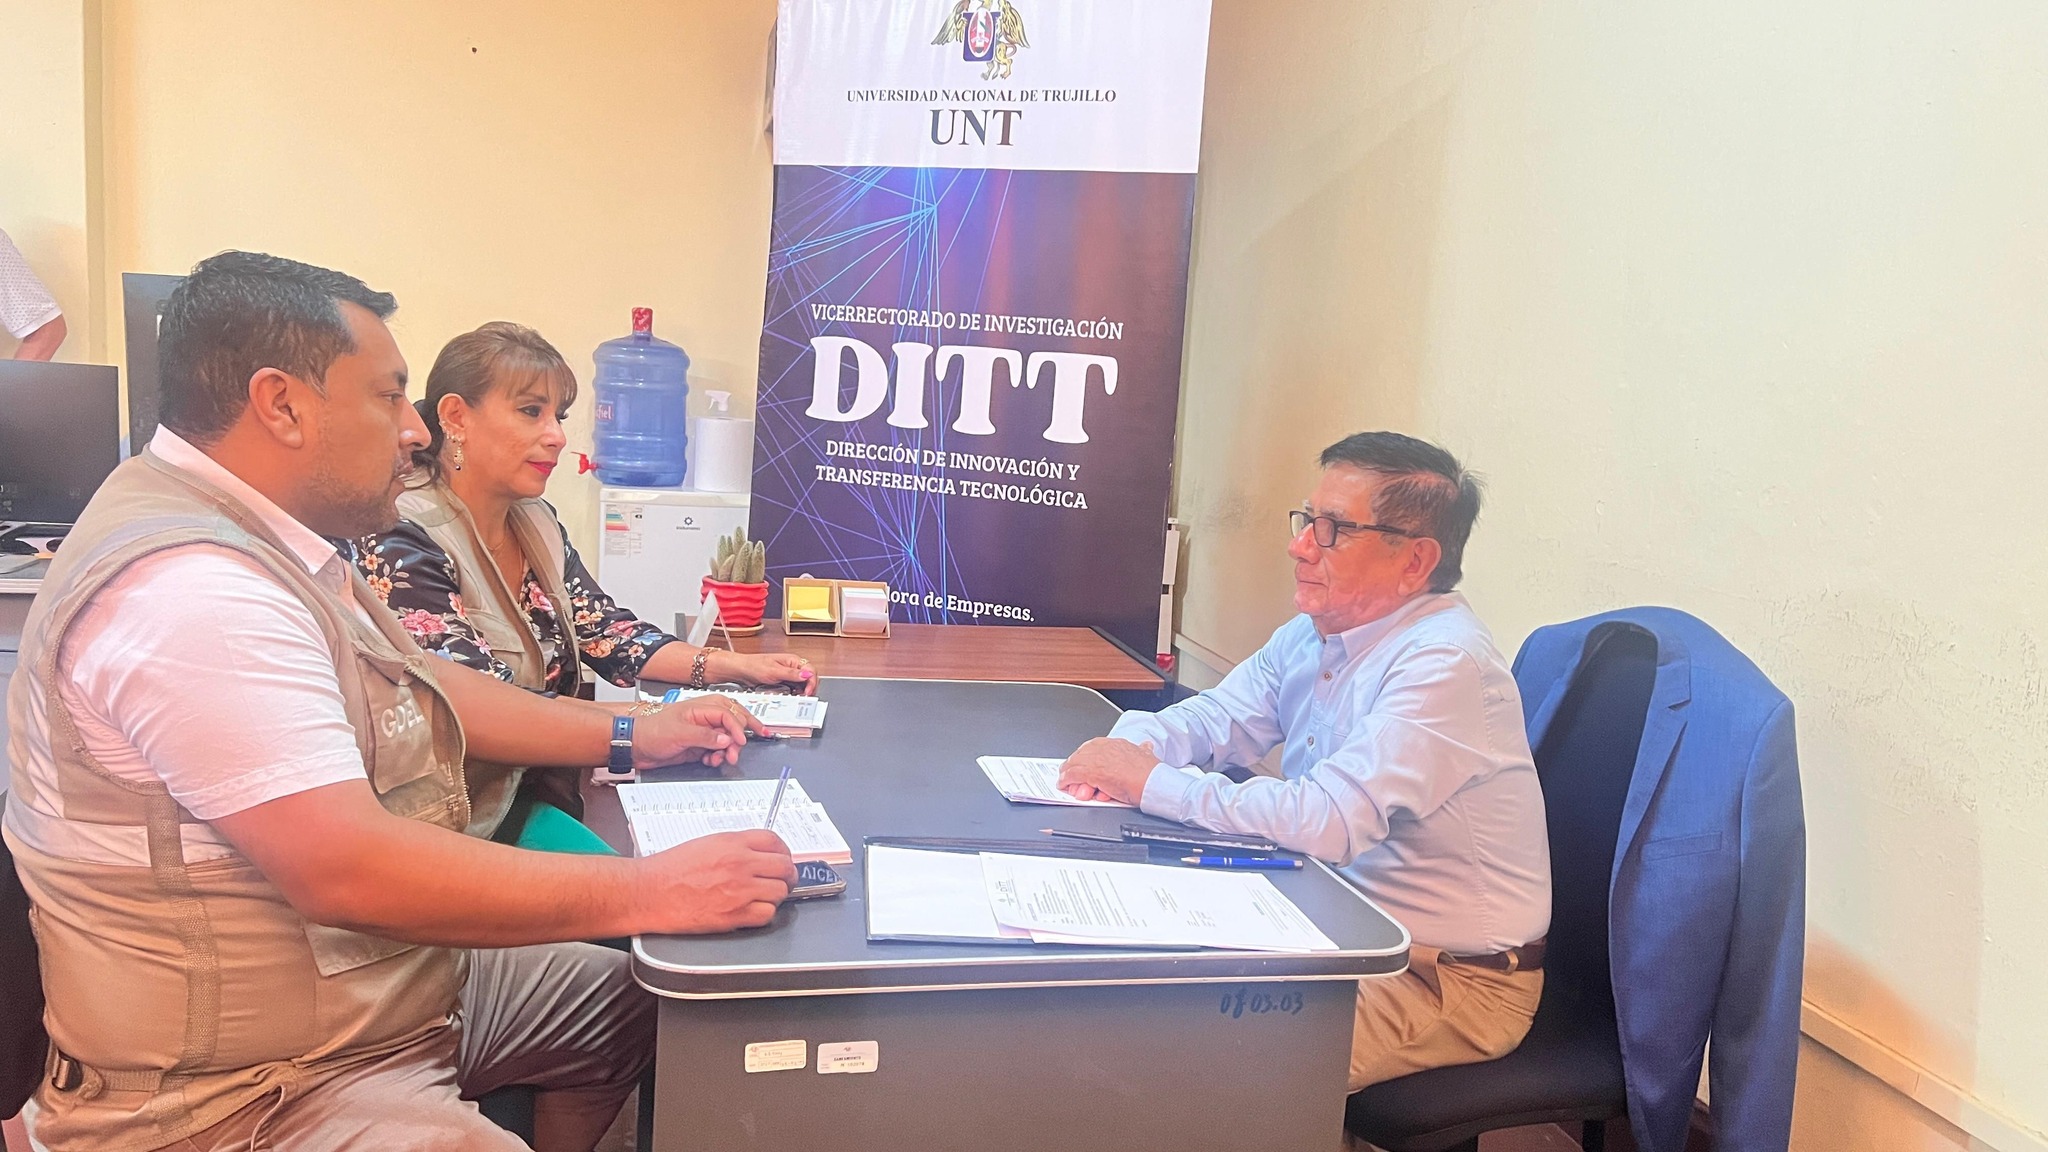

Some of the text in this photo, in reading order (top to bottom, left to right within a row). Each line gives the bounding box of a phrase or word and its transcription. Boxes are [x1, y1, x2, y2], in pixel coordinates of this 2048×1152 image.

[847, 89, 1117, 103] UNIVERSIDAD NACIONAL DE TRUJILLO
[929, 108, 1022, 146] UNT
[811, 303, 1124, 340] VICERRECTORADO DE INVESTIGACIÓN
[804, 335, 1119, 444] DITT
[825, 439, 1081, 482] DIRECCIÓN DE INNOVACIÓN Y
[815, 464, 1088, 509] TRANSFERENCIA TECNOLÓGICA
[923, 591, 943, 608] de
[946, 595, 1035, 622] Empresas.
